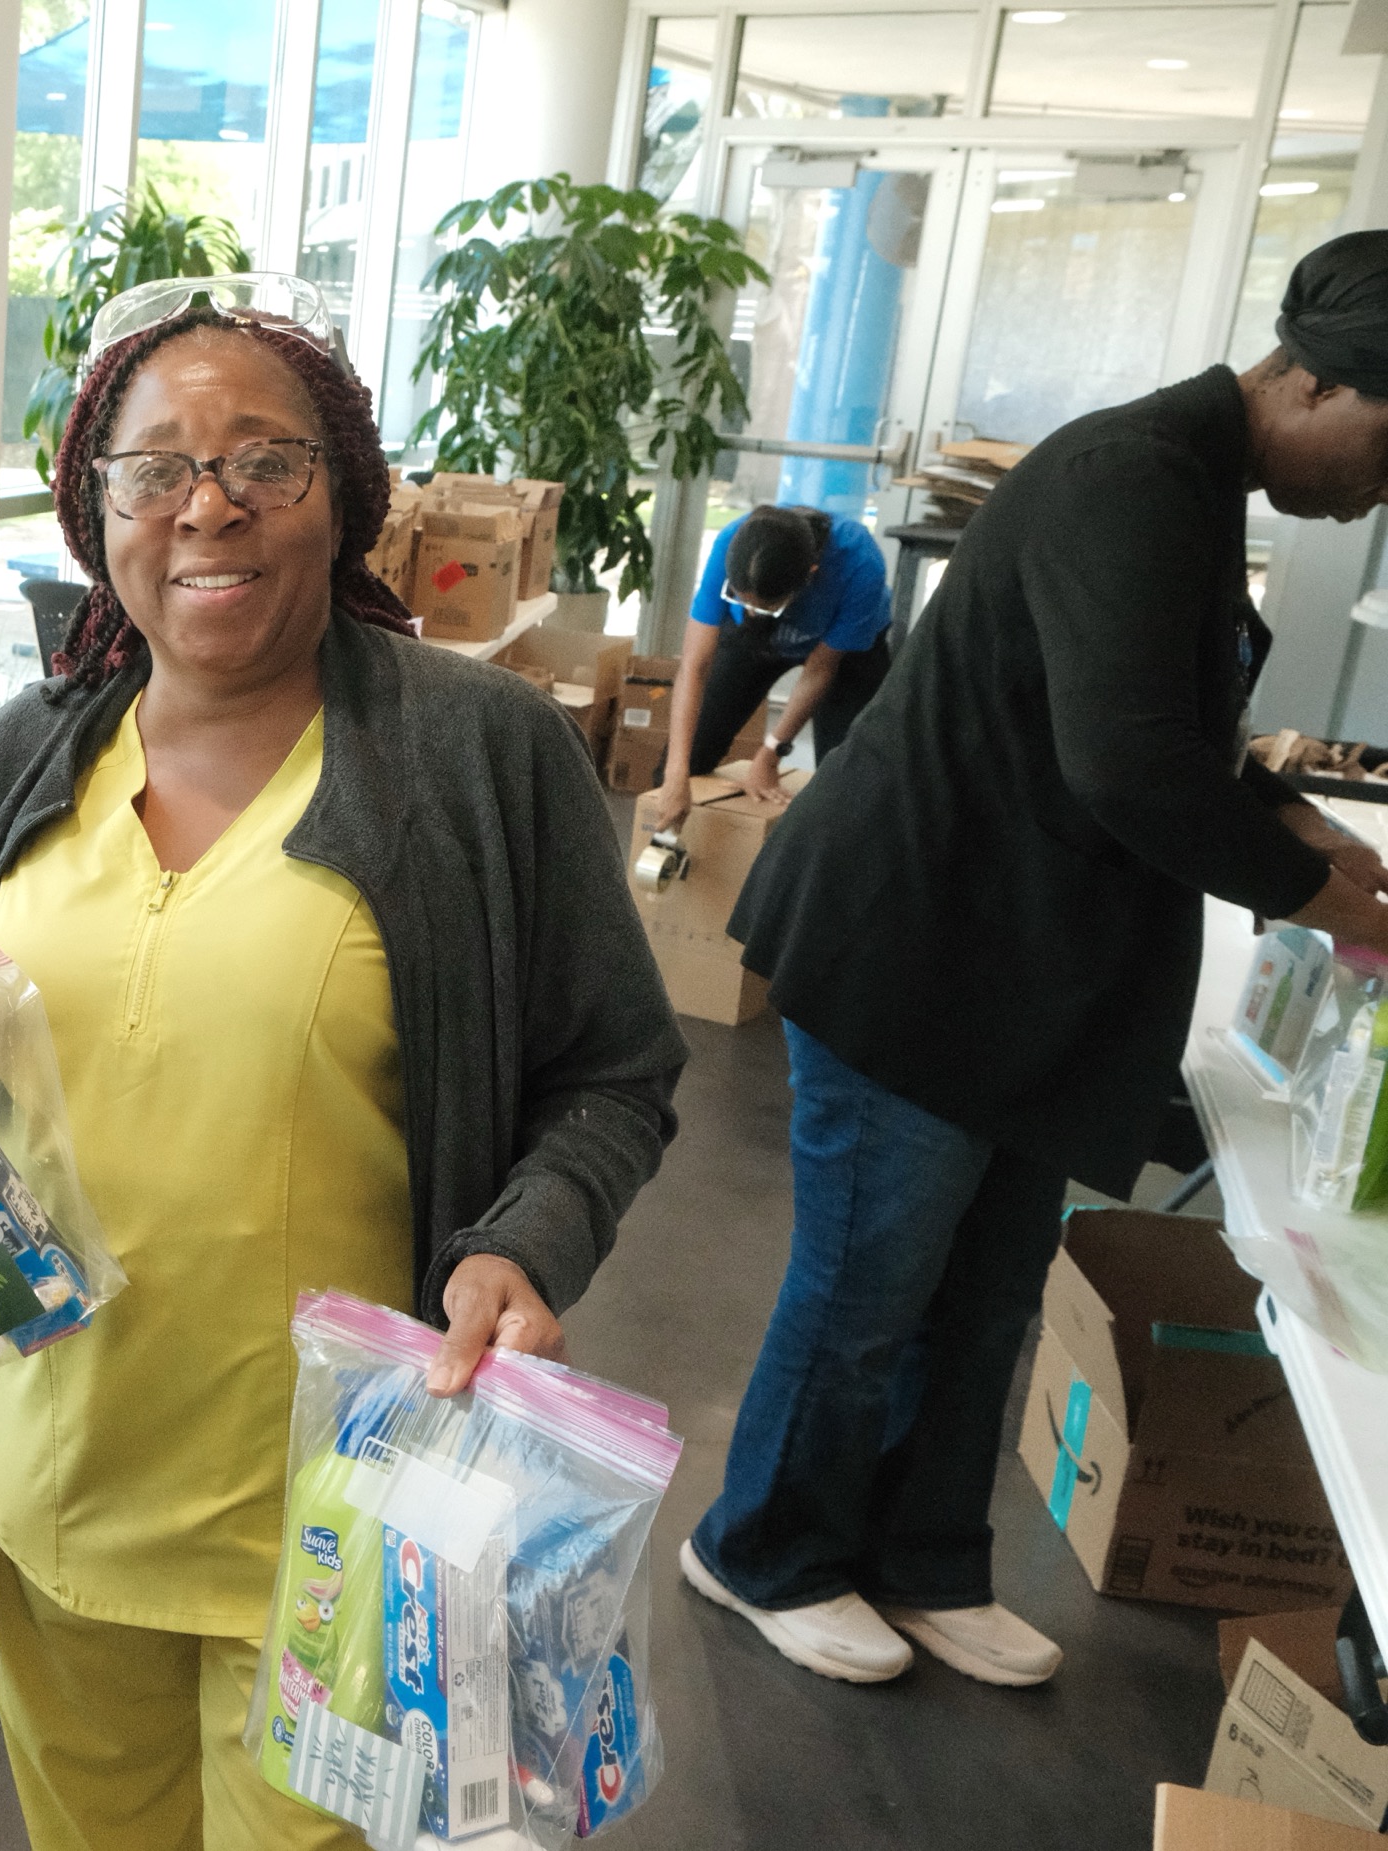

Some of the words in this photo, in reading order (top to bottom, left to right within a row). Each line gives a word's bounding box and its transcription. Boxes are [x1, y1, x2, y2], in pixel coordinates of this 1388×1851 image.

[301, 1527, 336, 1553] Suave
[1185, 1505, 1247, 1532] Wish
[1252, 1518, 1302, 1538] you
[1304, 1525, 1336, 1543] co
[317, 1551, 342, 1570] kids
[1177, 1531, 1235, 1557] stay
[1238, 1537, 1263, 1557] in
[1267, 1541, 1334, 1566] bed?
[401, 1540, 424, 1693] Crest
[436, 1632, 444, 1648] 2X
[421, 1720, 435, 1771] COLOR
[597, 1678, 622, 1802] Cres
[1228, 1722, 1239, 1742] 6
